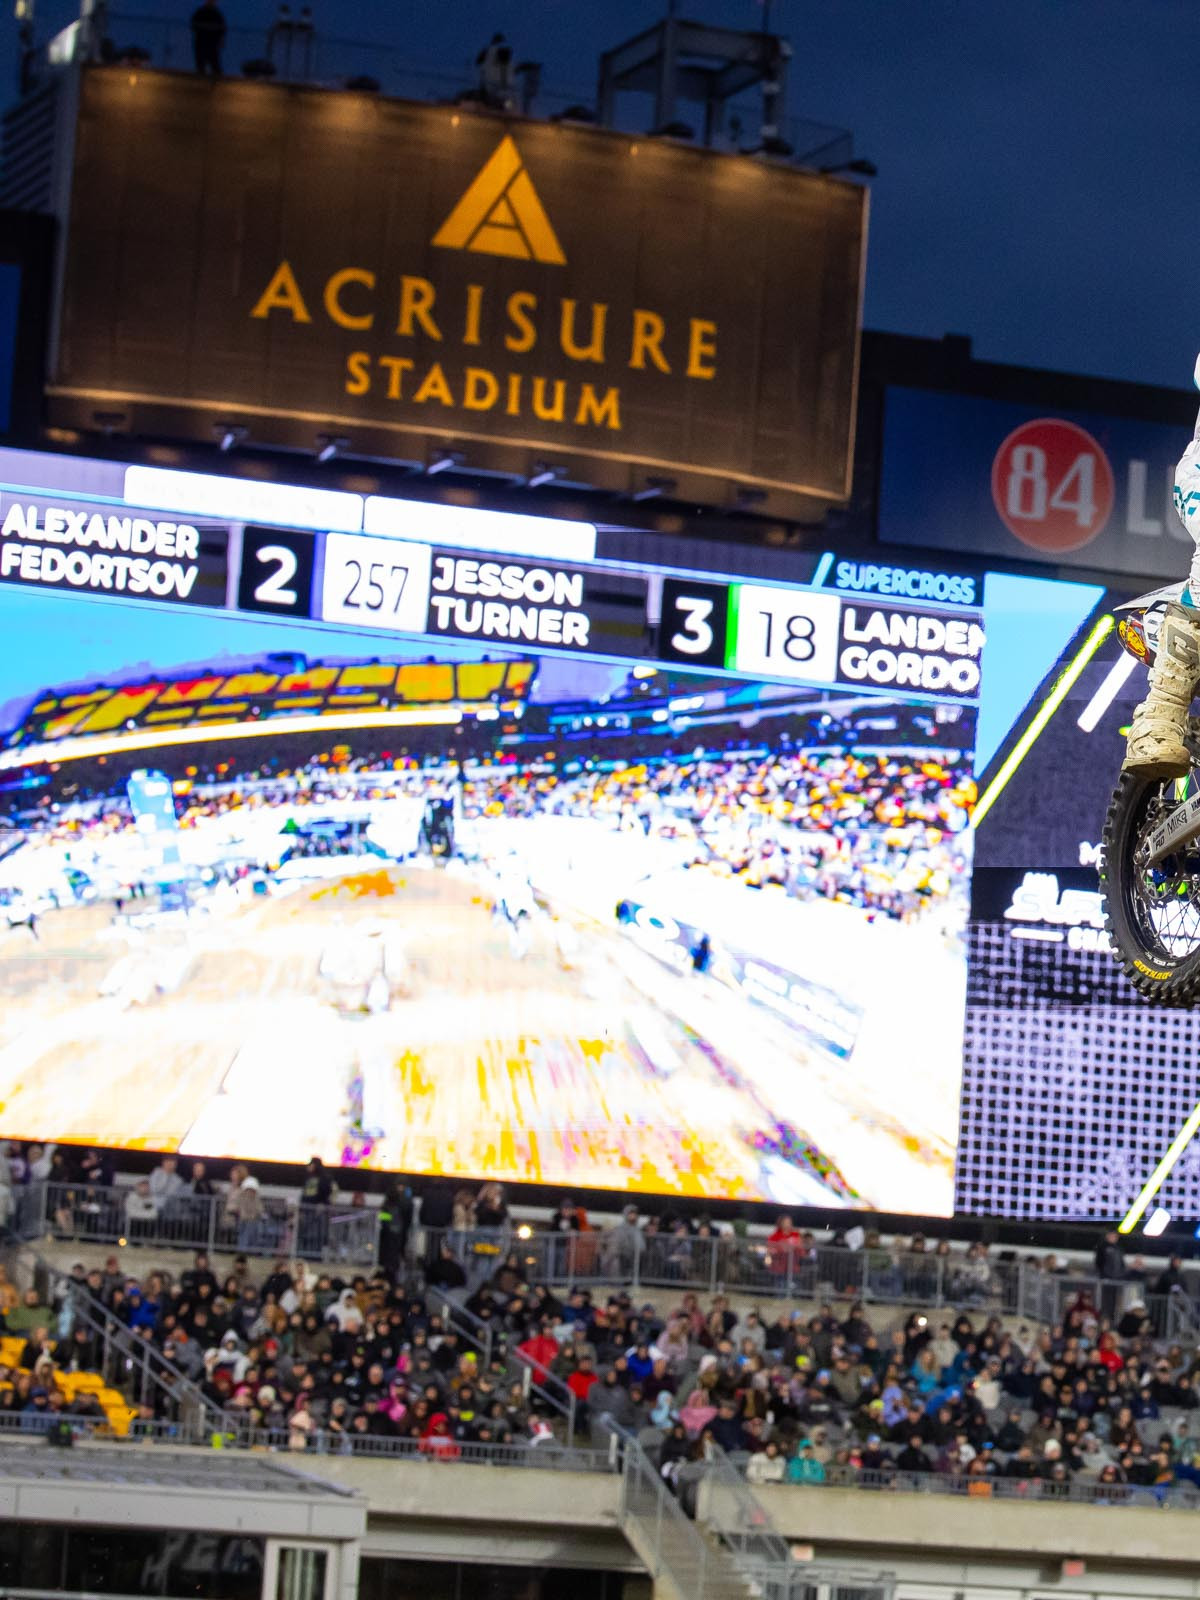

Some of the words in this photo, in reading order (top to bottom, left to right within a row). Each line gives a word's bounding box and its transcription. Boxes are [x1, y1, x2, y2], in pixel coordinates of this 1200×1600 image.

[250, 260, 718, 380] ACRISURE
[345, 351, 622, 430] STADIUM
[1006, 444, 1099, 528] 84
[1, 503, 200, 560] ALEXANDER
[1, 543, 199, 598] FEDORTSOV
[254, 545, 298, 605] 2
[342, 559, 409, 613] 257
[431, 556, 584, 607] JESSON
[836, 561, 976, 604] SUPERCROSS
[430, 596, 590, 646] TURNER
[670, 597, 714, 654] 3
[758, 611, 816, 662] 18
[1133, 959, 1172, 980] DUNLOP
